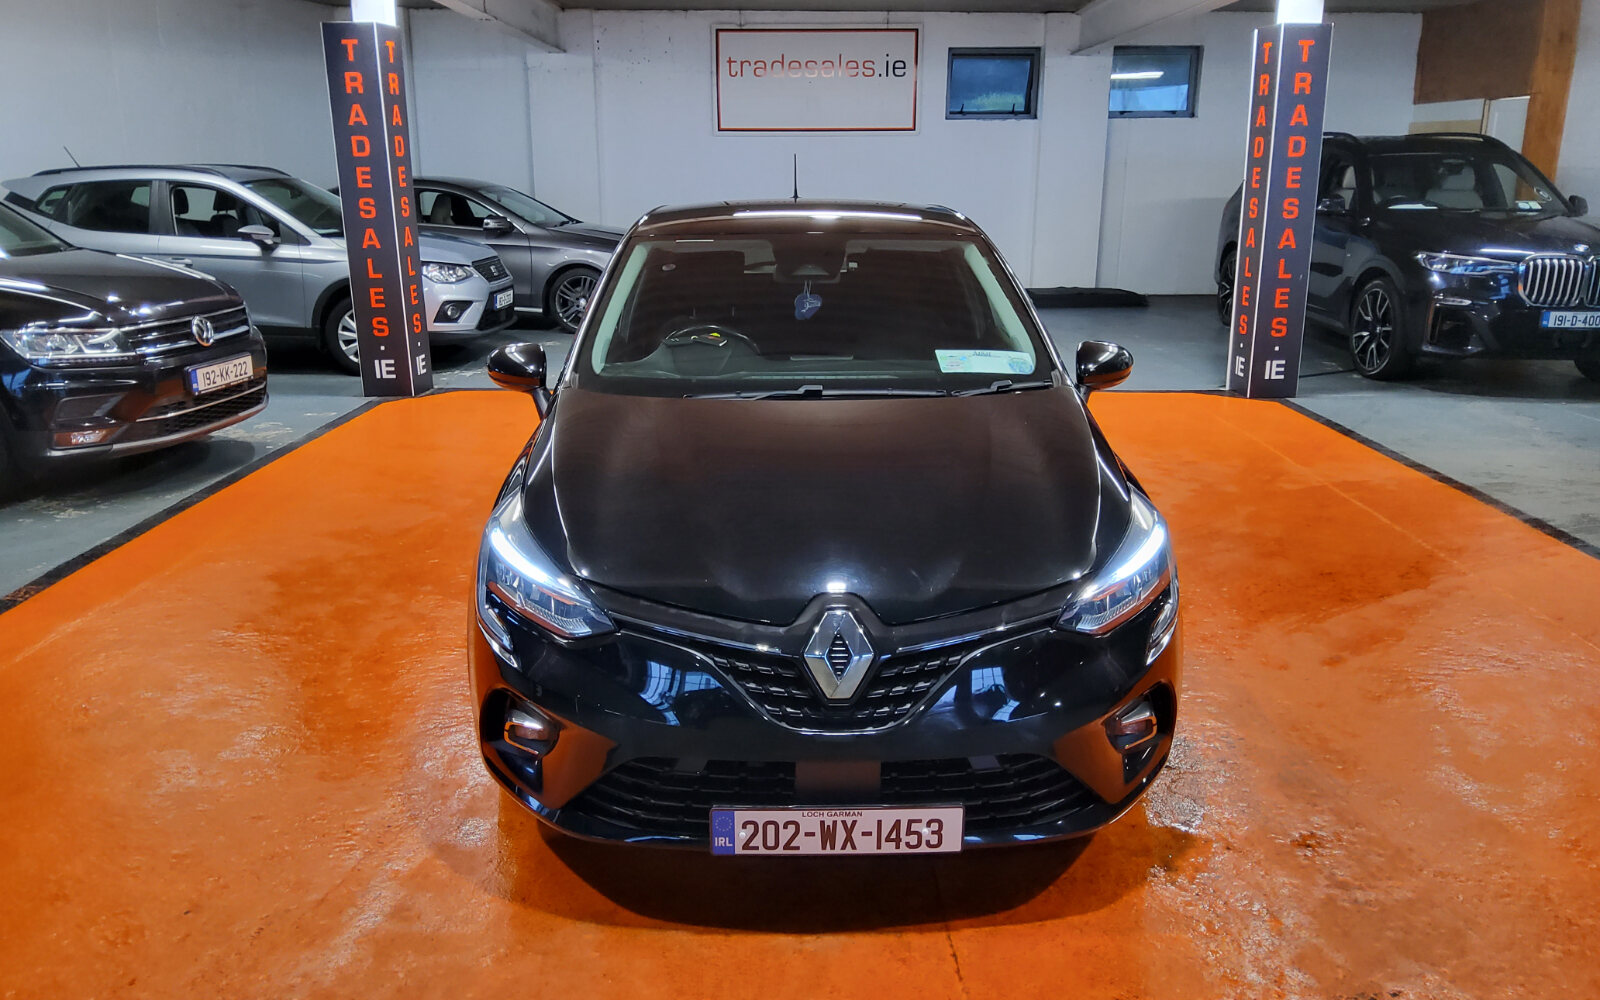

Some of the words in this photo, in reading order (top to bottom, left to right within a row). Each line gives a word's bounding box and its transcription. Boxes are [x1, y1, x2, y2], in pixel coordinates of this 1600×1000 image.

[726, 53, 907, 78] tradesales.ie
[202, 361, 248, 387] 192-KK-222
[826, 810, 863, 818] GARMAN
[714, 837, 733, 847] IRL
[741, 818, 944, 851] 202-WX-1453
